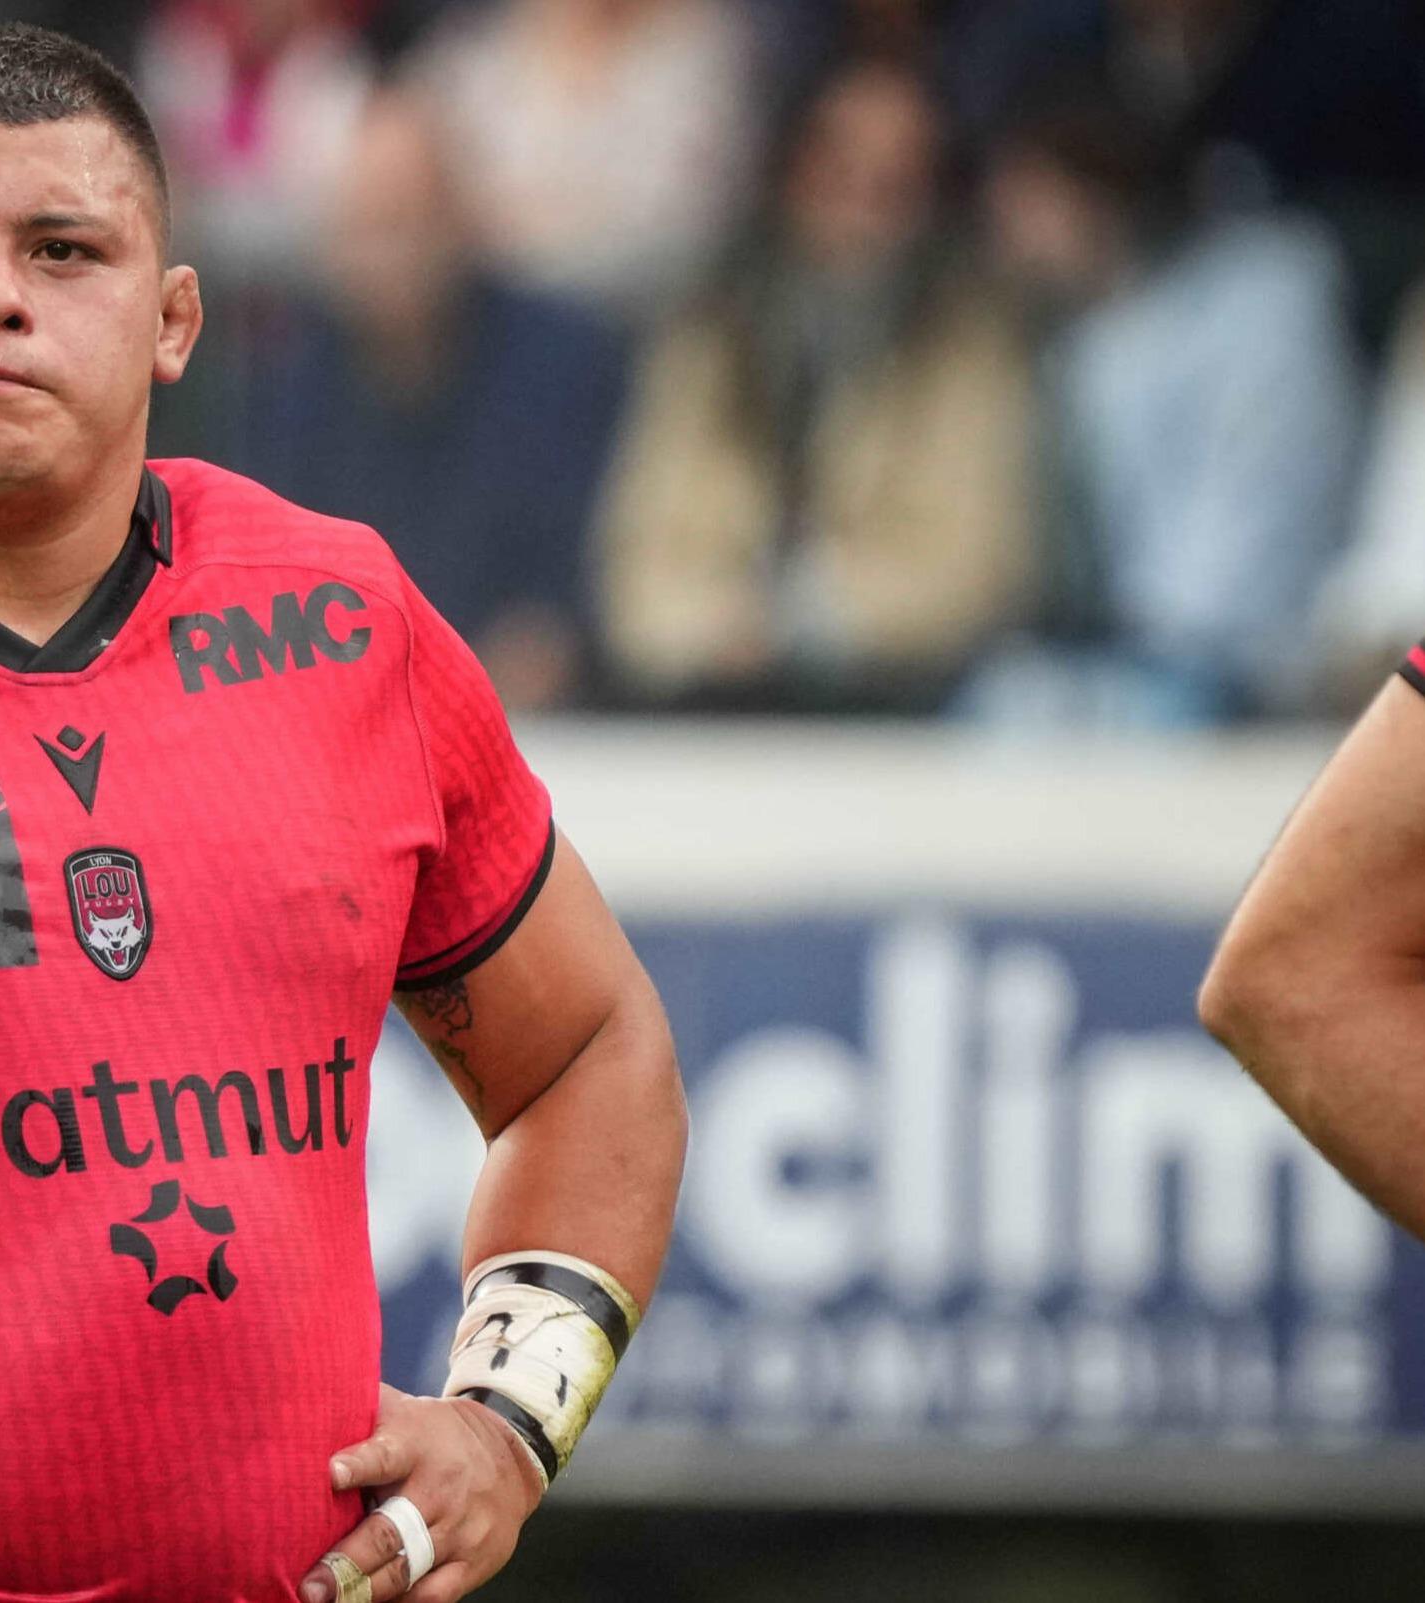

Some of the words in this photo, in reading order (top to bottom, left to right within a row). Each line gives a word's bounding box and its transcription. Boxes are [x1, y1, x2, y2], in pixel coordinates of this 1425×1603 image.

[169, 581, 372, 694] RMC
[89, 856, 112, 867] LYON
[79, 871, 131, 900] LOU
